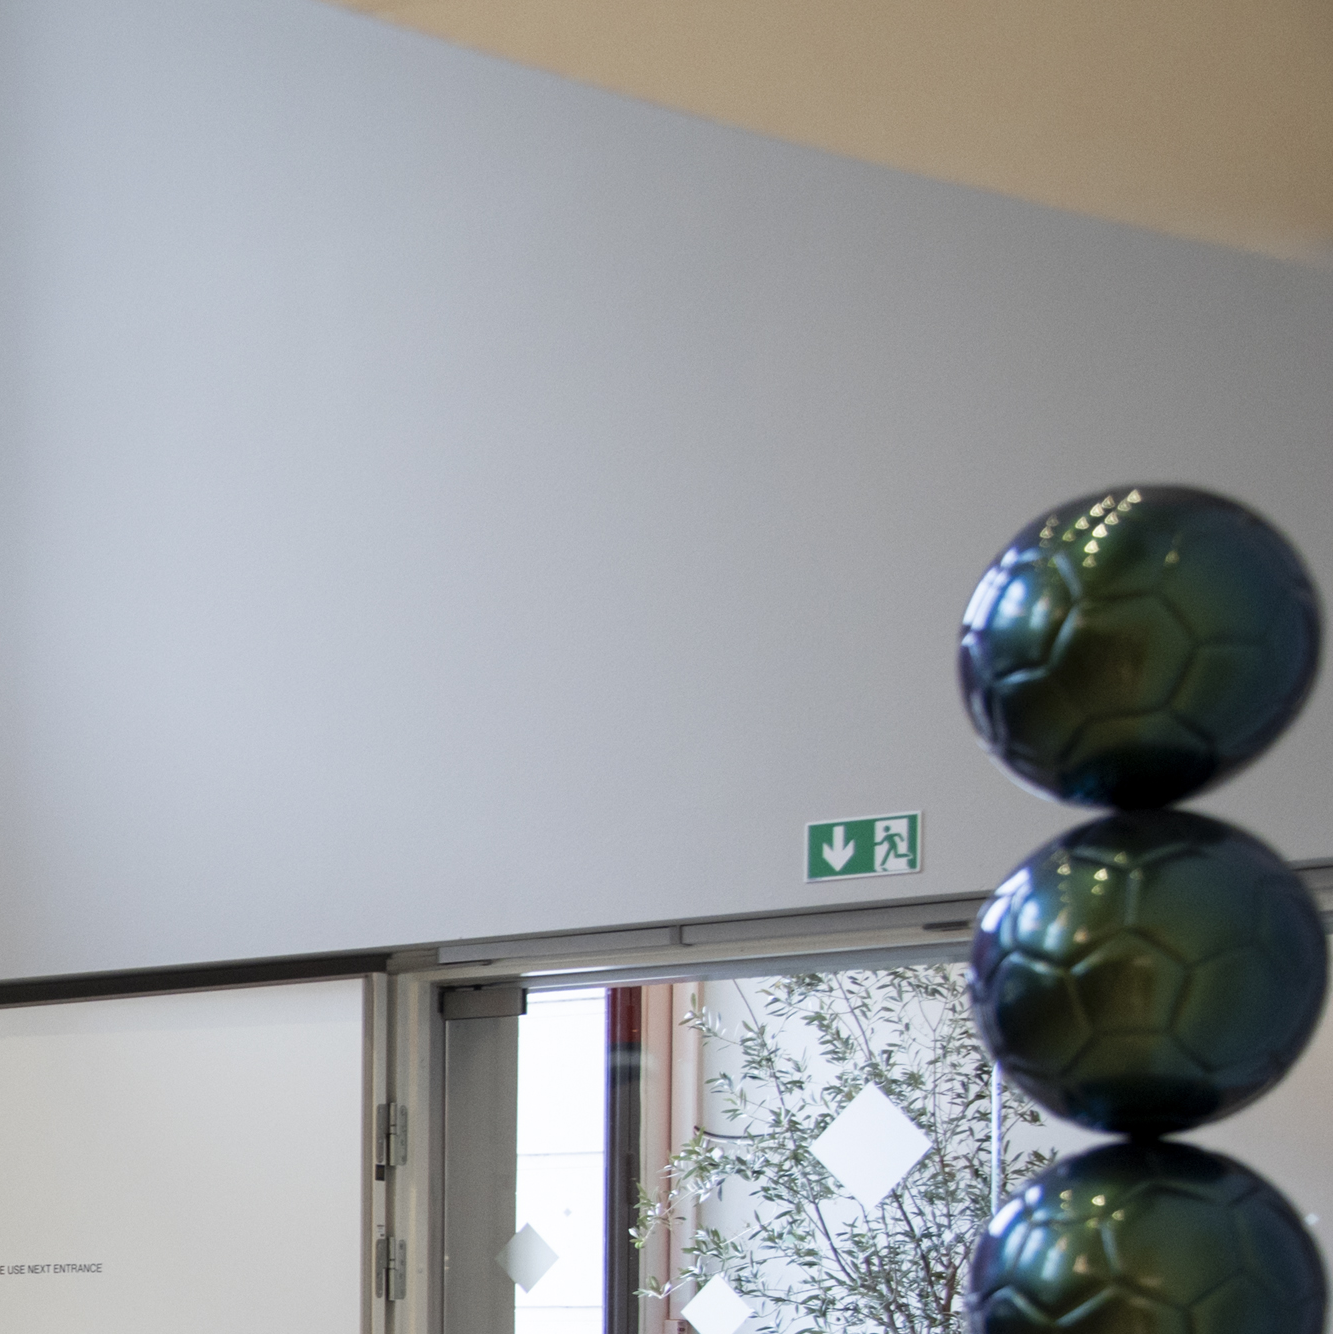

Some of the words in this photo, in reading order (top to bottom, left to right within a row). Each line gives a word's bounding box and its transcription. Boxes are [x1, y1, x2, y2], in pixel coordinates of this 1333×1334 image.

[7, 1265, 26, 1275] USE
[27, 1264, 51, 1274] NEXT
[53, 1263, 103, 1274] ENTRANCE
